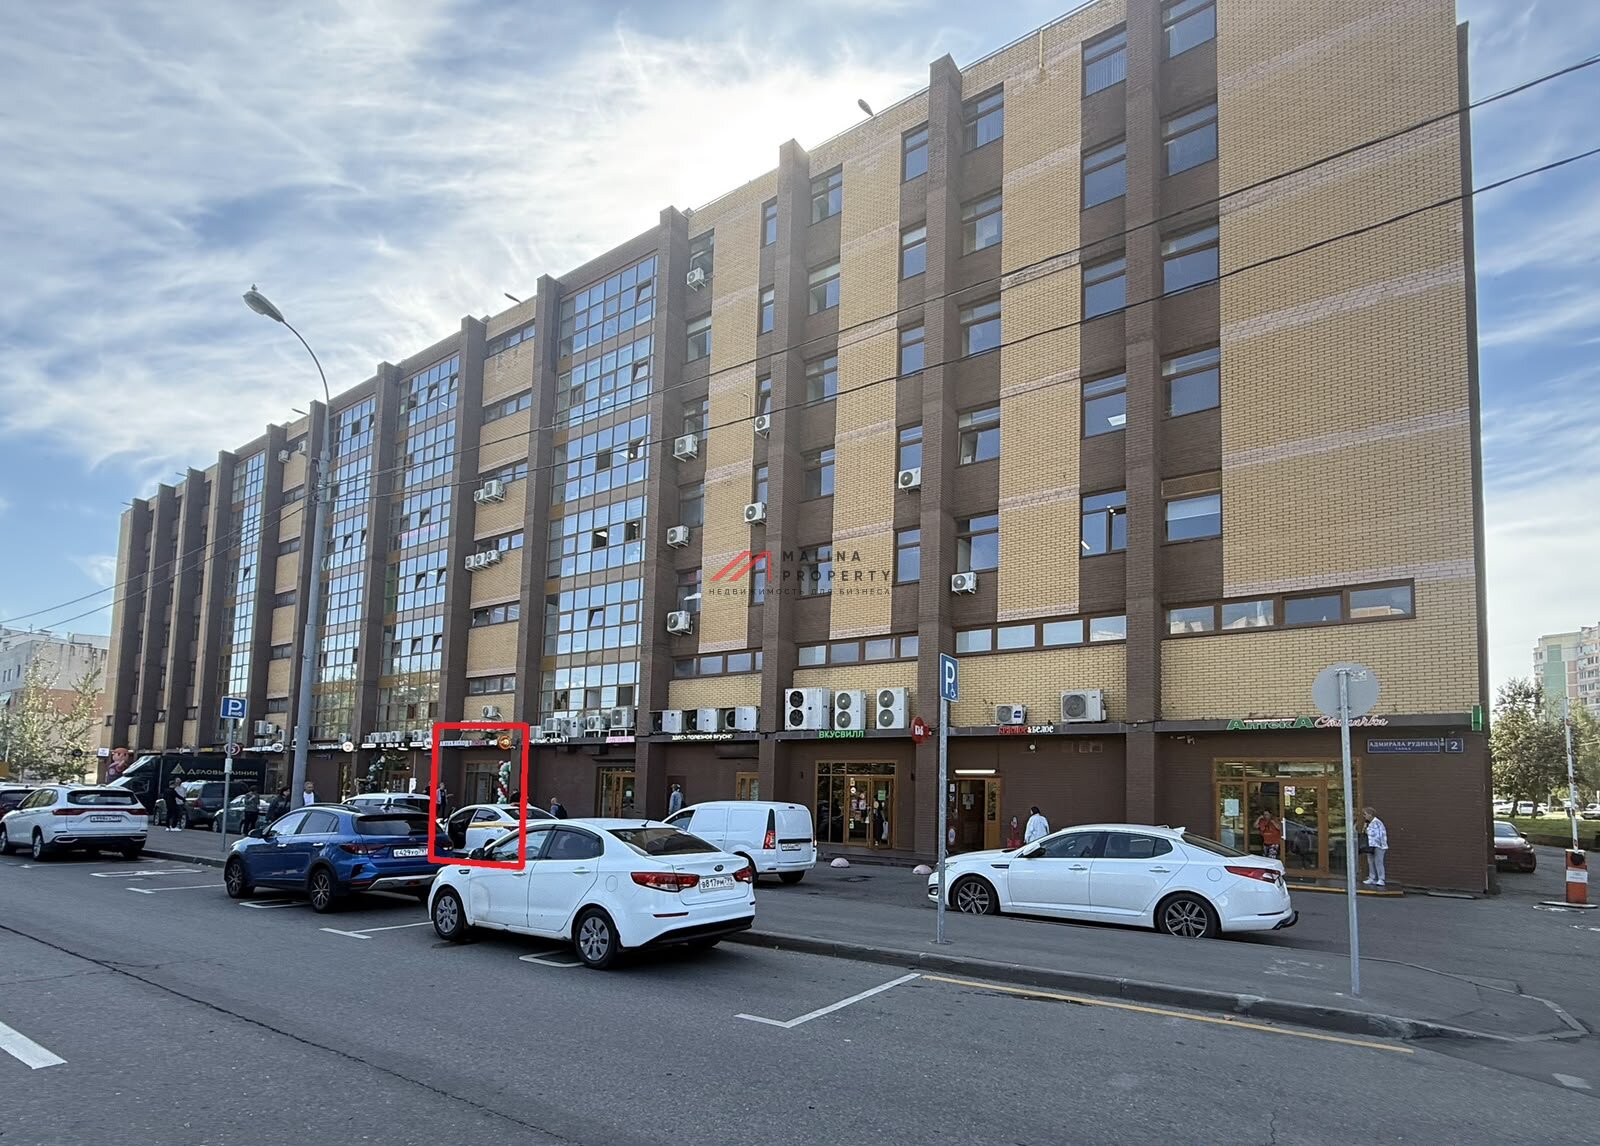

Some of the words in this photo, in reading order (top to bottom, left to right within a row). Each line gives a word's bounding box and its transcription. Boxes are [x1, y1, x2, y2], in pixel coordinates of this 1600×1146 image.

[945, 660, 955, 694] P
[228, 699, 242, 716] P
[1450, 741, 1458, 750] 2
